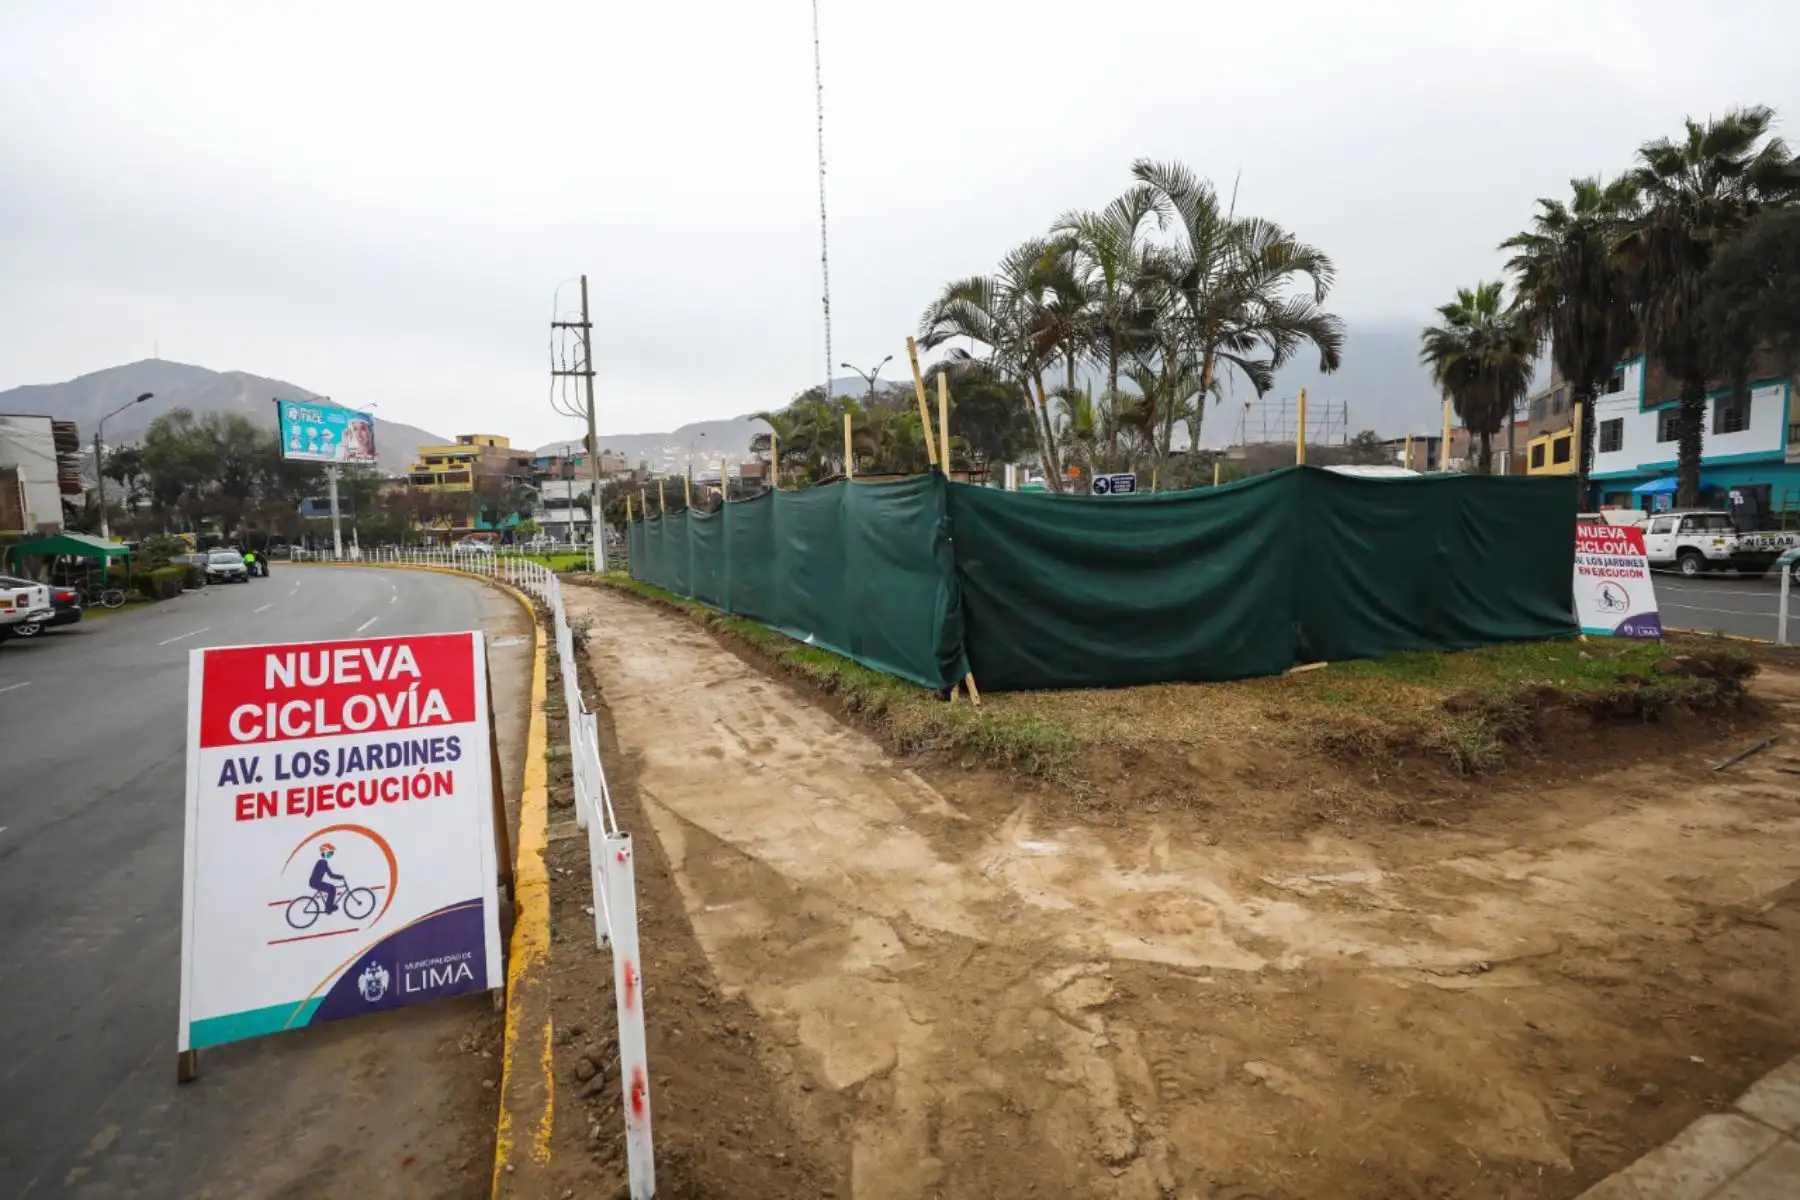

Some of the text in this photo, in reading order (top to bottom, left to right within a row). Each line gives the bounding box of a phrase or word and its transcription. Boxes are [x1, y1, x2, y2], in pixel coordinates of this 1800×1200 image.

[1577, 526, 1627, 539] NUEVA
[1745, 536, 1794, 546] NISSAN
[1579, 566, 1591, 576] EN
[1587, 557, 1604, 566] LOS
[1605, 557, 1645, 568] JARDINES
[265, 644, 422, 690] NUEVA
[228, 682, 452, 742] CICLOVÍA
[218, 735, 462, 787] AV. LOS JARDINES
[235, 768, 453, 821] EN EJECUCIÓN
[404, 953, 461, 970] MUNICIPALIDAD
[405, 962, 475, 993] LIMA
